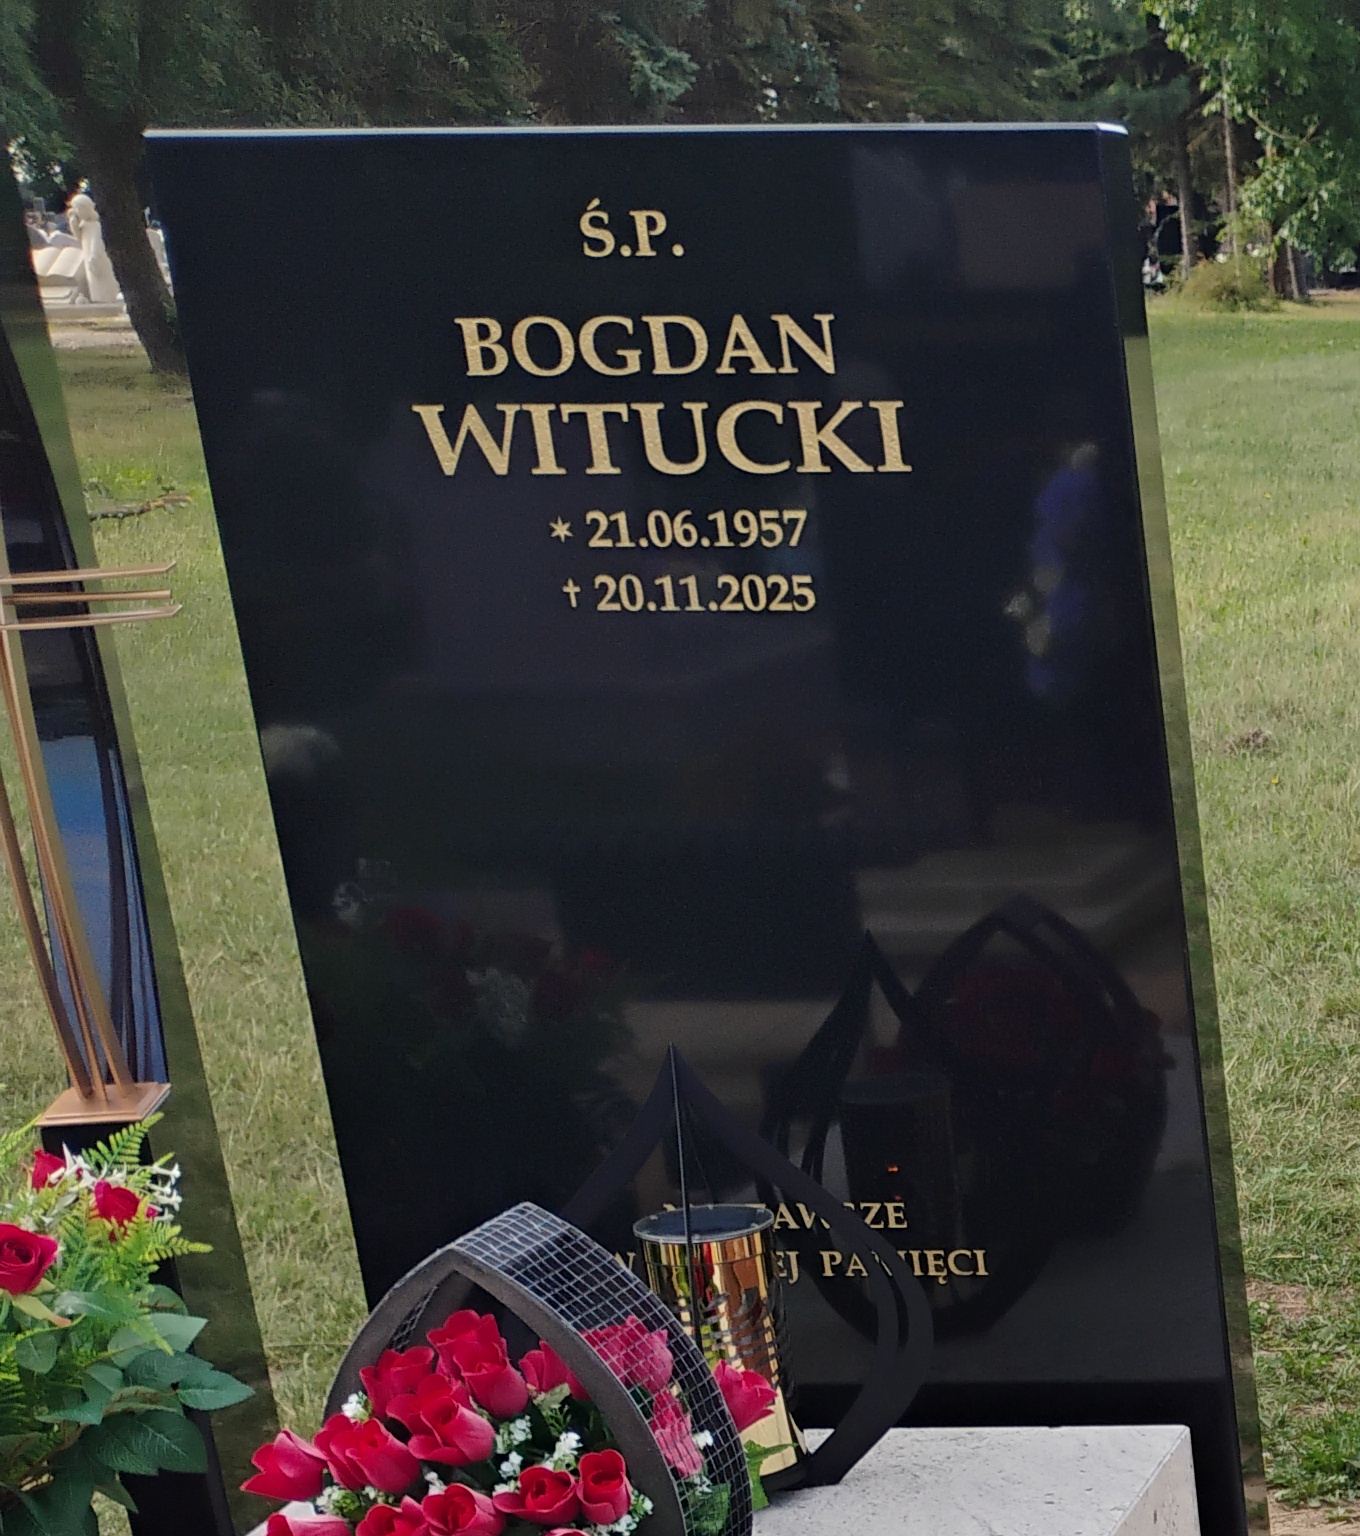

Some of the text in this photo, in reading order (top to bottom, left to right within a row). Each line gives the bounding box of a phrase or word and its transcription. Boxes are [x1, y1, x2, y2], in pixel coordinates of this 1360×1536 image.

[579, 197, 685, 257] Ś.P.
[453, 313, 836, 377] BOGDAN
[411, 400, 913, 476] WITUCKI
[585, 509, 808, 548] 21.06.1957
[594, 573, 816, 612] 20.11.2025
[819, 1249, 989, 1285] PAIĘCI
